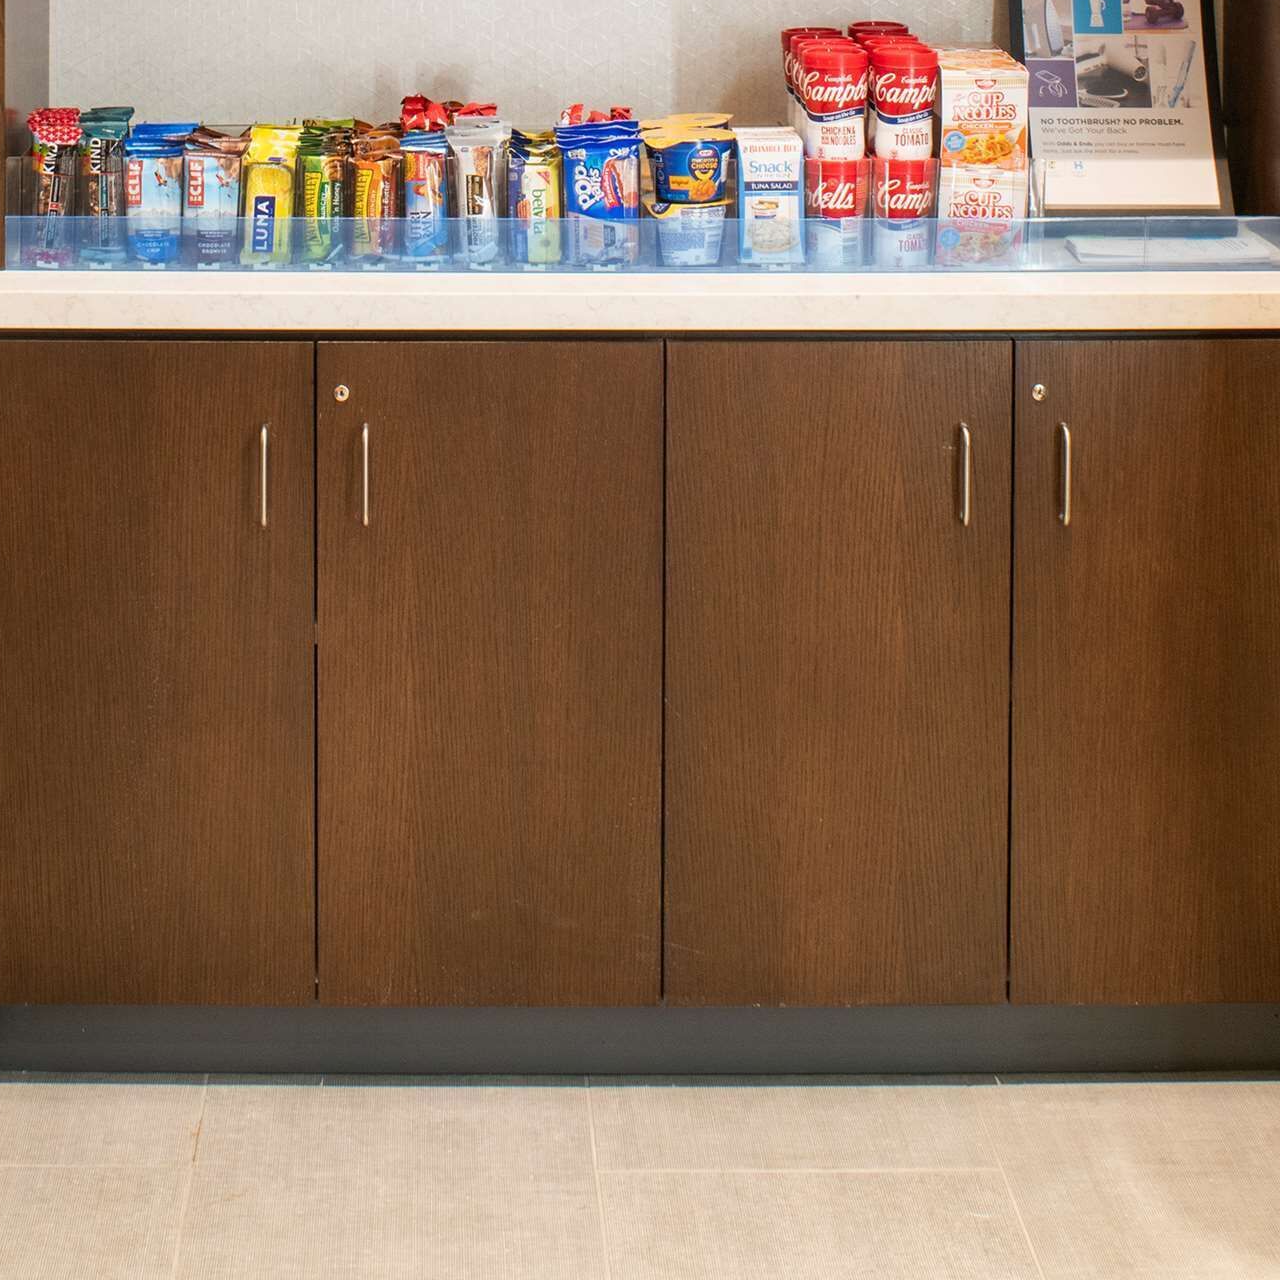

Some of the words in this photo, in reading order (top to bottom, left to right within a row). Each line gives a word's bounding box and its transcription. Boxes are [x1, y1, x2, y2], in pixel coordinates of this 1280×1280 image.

[968, 92, 1005, 109] CUP
[952, 105, 1016, 121] NOODLES
[1040, 118, 1054, 126] NO
[1057, 118, 1121, 126] TOOTHBRUSH?
[1123, 118, 1137, 126] NO
[1139, 118, 1184, 126] PROBLEM.
[821, 126, 849, 135] CHICKEN
[830, 135, 857, 146] NOODLES
[895, 133, 929, 146] TOMATO
[42, 142, 59, 175] KIND
[90, 137, 101, 175] KIND
[749, 161, 792, 174] Snack
[128, 162, 141, 195] CLIF
[190, 162, 202, 195] CLIF
[964, 191, 1002, 206] CUP
[948, 203, 1013, 218] NOODLES
[255, 200, 270, 251] LUNA
